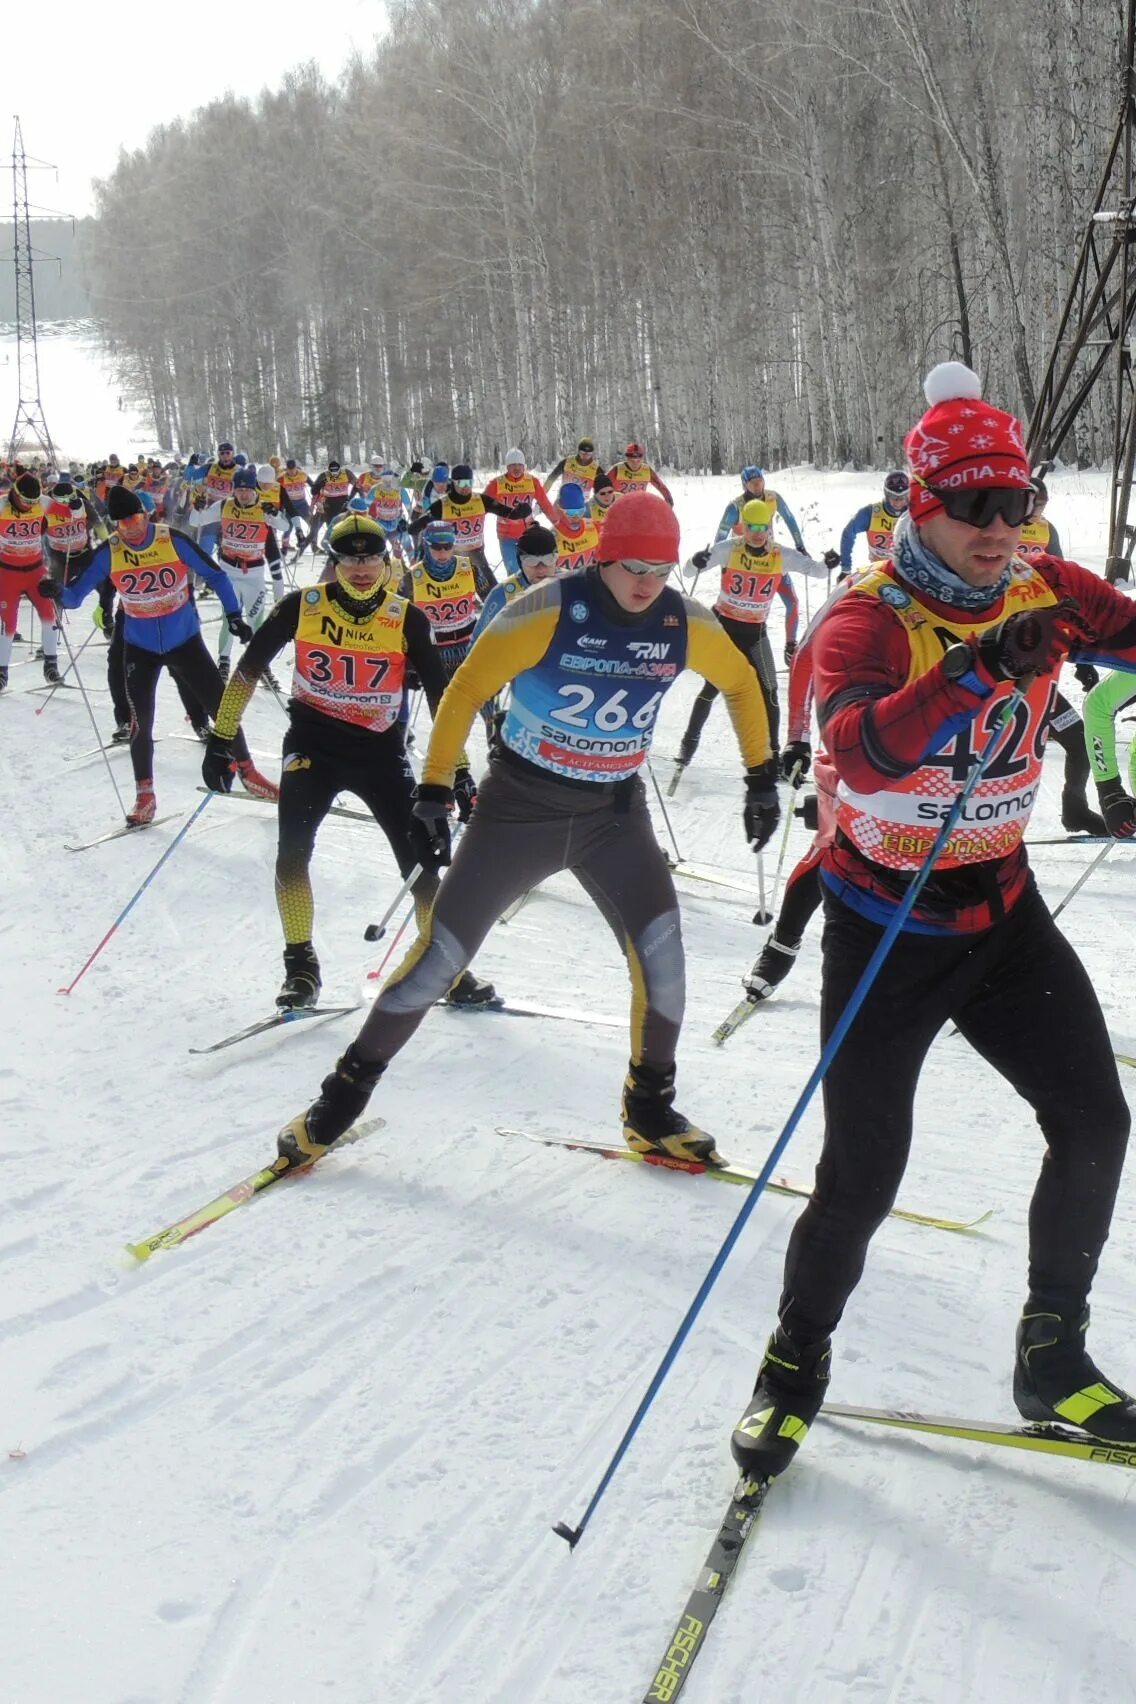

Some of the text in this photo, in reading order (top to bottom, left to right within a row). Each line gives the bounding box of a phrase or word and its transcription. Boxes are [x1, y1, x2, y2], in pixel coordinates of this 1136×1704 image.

[6, 521, 40, 537] 430
[225, 522, 260, 540] 427
[120, 567, 176, 595] 220
[730, 574, 774, 598] 314
[424, 599, 469, 621] 320
[377, 616, 402, 630] RAY
[345, 629, 374, 642] NIKA
[626, 641, 671, 660] RAY
[308, 650, 390, 689] 317
[559, 652, 677, 678] ЕВРОПА-АЗИЯ
[551, 684, 663, 732] 266
[648, 1614, 705, 1702] FISCHER
